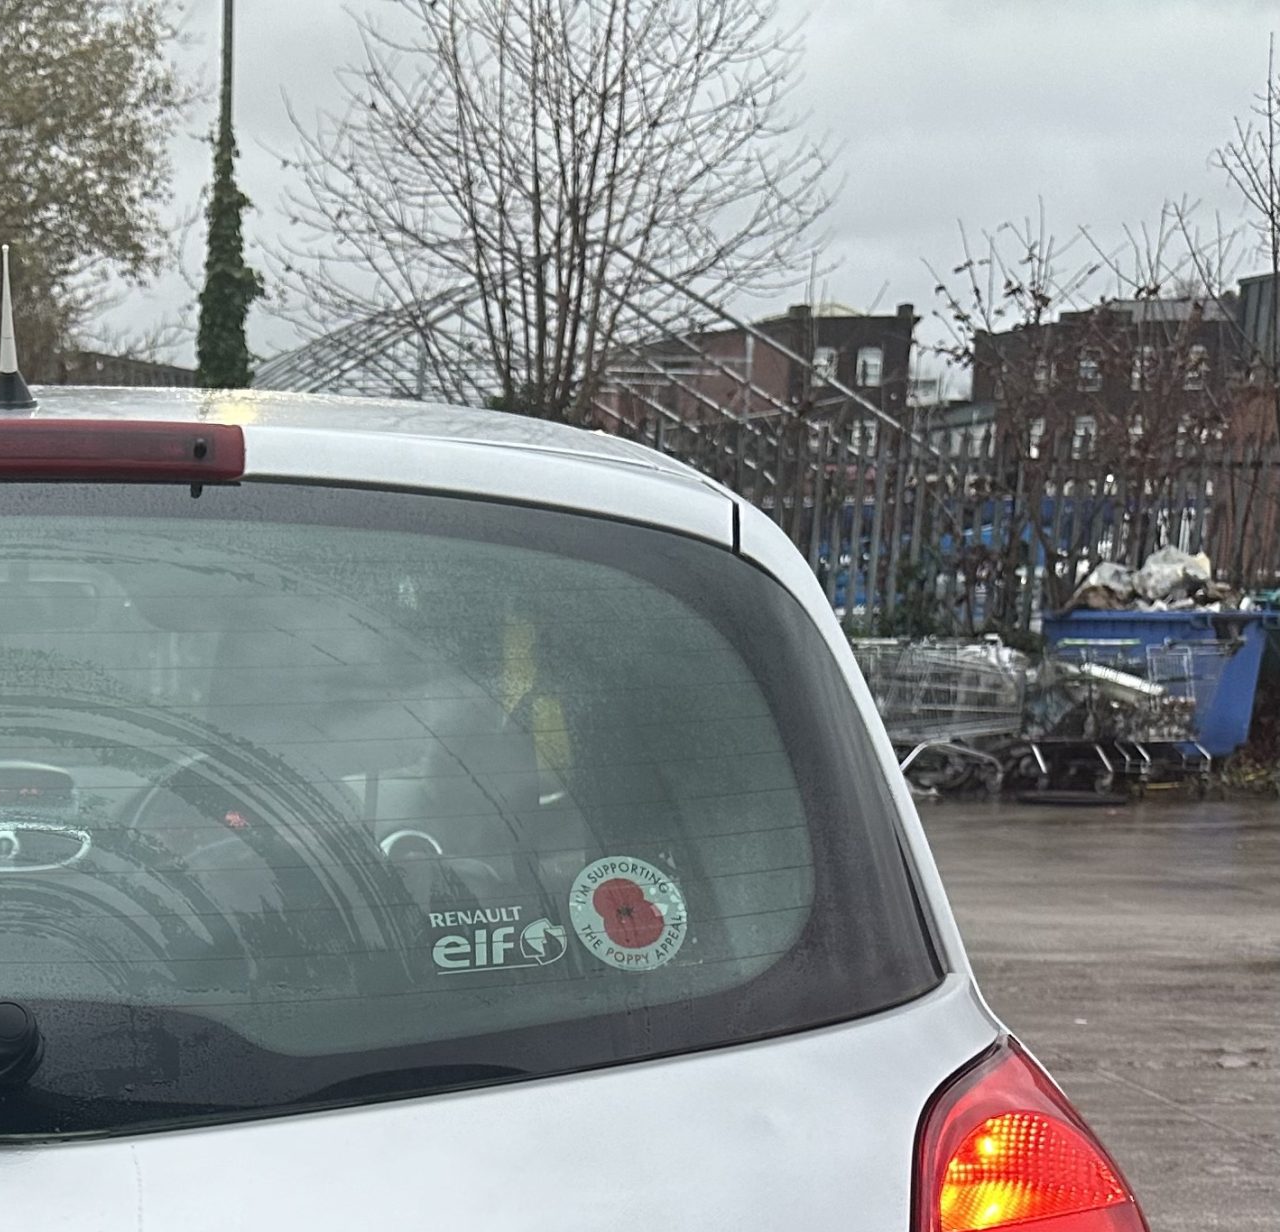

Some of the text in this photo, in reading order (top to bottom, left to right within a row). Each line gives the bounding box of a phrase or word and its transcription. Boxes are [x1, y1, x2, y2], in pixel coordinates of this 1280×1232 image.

[575, 862, 669, 904] I'M SUPPORTING
[428, 905, 522, 928] RENAULT
[432, 926, 515, 968] elf
[581, 915, 682, 965] THE POPPY APPEAL
